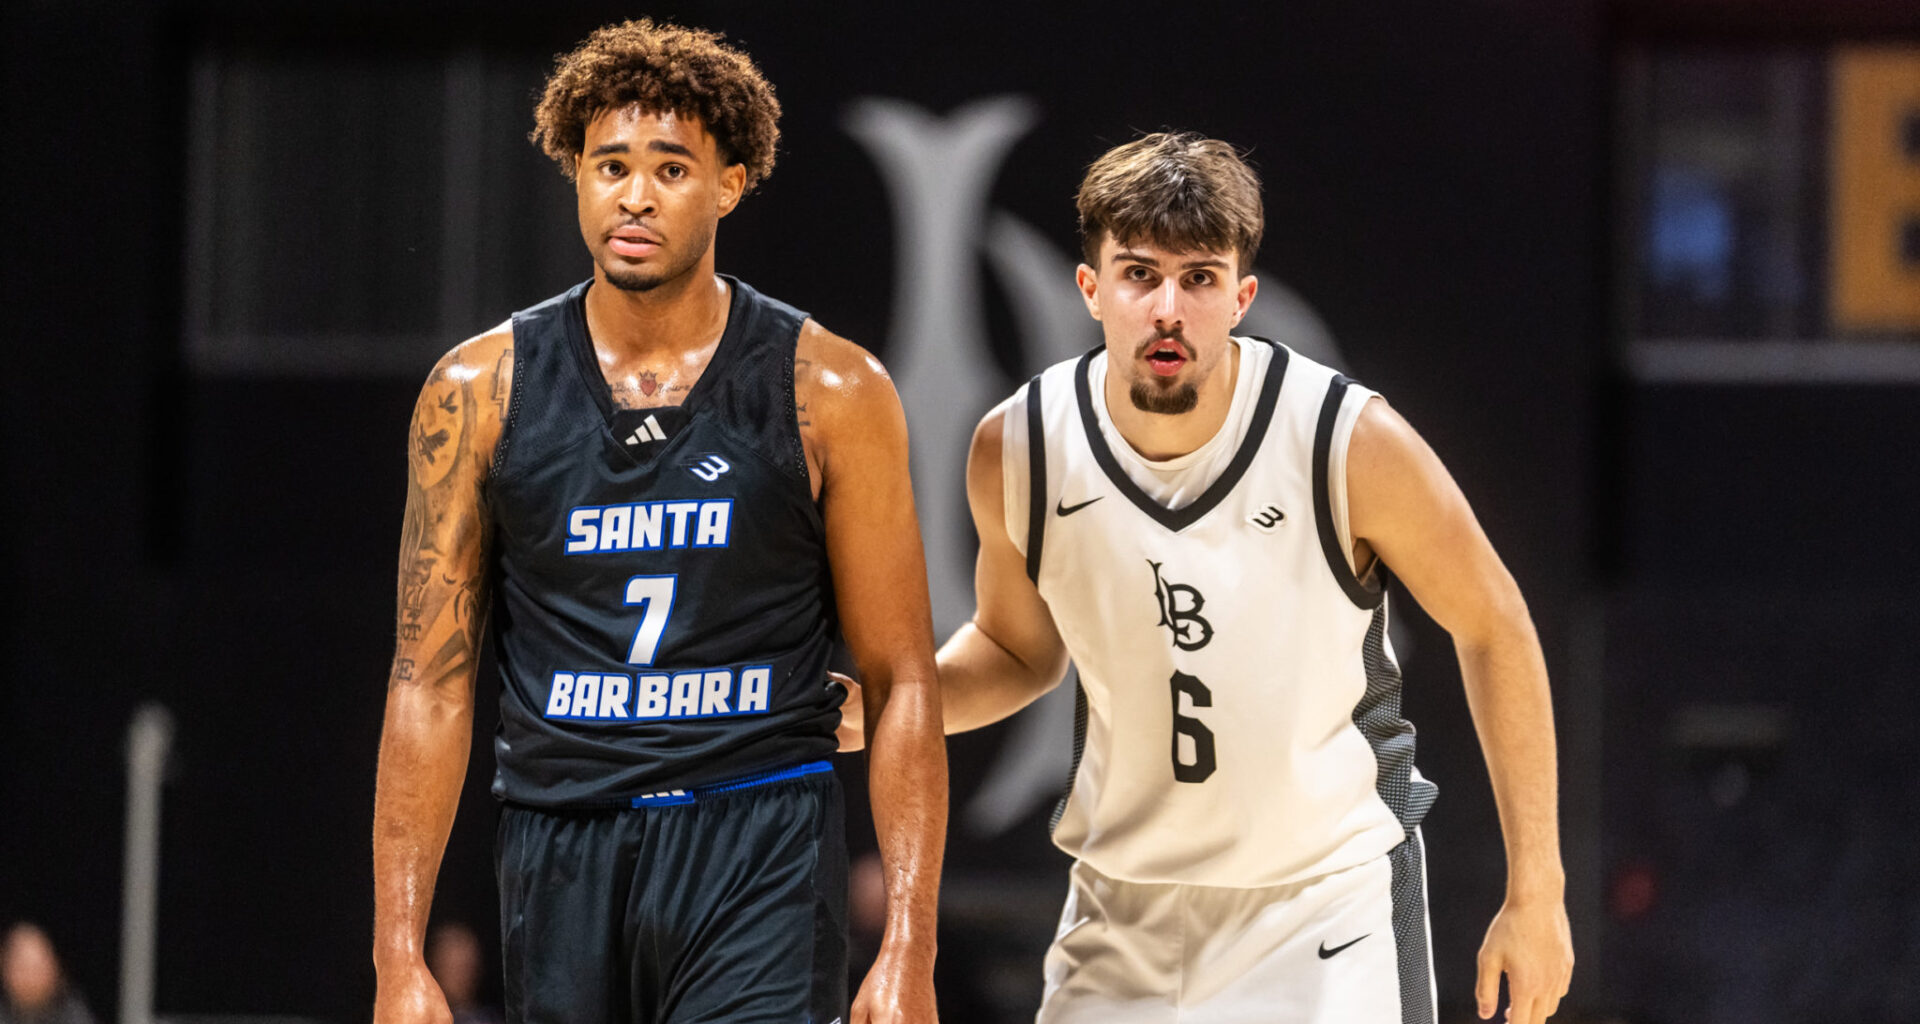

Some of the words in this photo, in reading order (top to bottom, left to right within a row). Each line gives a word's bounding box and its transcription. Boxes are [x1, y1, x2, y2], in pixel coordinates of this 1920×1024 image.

[564, 499, 734, 555] SANTA
[622, 573, 678, 667] 7
[544, 665, 773, 721] BARBARA
[1170, 669, 1217, 783] 6
